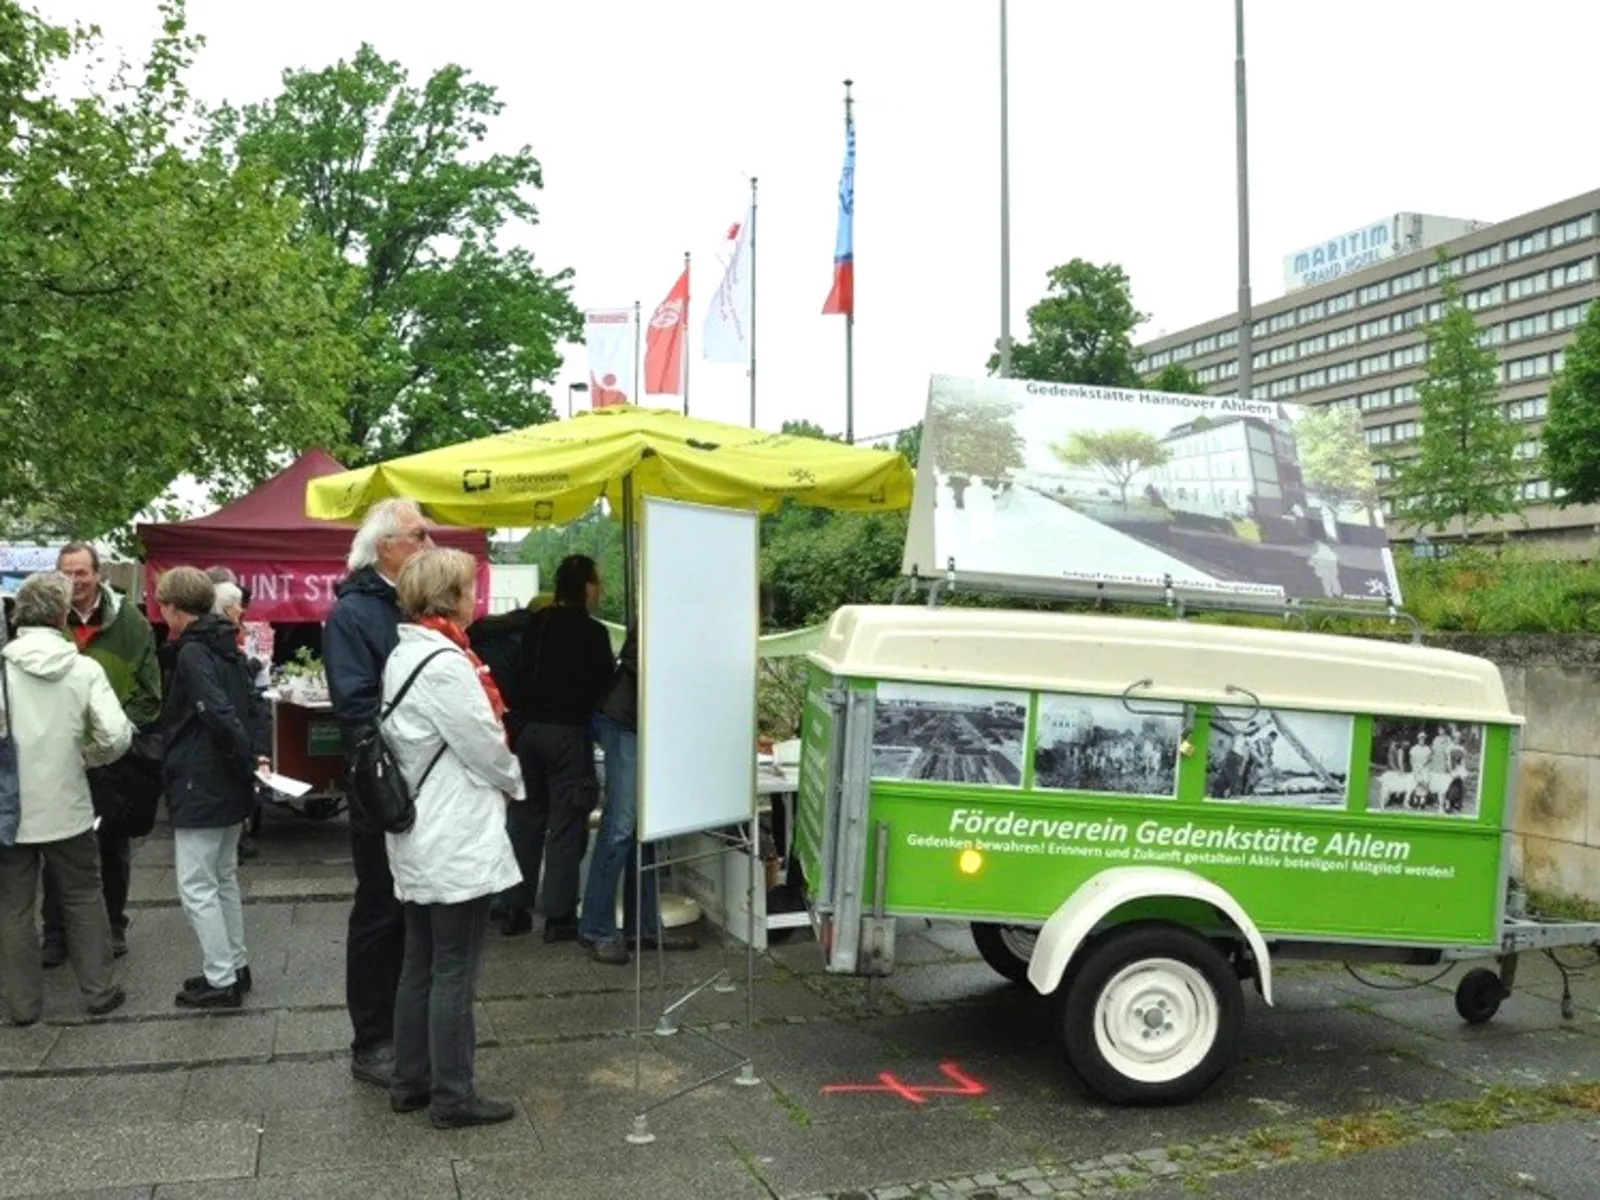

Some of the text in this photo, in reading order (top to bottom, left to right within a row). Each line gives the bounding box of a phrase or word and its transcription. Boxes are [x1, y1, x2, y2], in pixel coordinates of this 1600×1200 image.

[1293, 224, 1388, 275] MARITIM
[1025, 381, 1273, 415] Gedenkstätte Hannover Ahlem
[240, 573, 295, 601] UNT
[949, 808, 1412, 861] Förderverein Gedenkstätte Ahlem
[1047, 843, 1103, 858] Erinnern
[1105, 848, 1130, 859] und
[1132, 848, 1182, 862] Zukunft
[1183, 852, 1247, 865] gestalten!
[1248, 854, 1281, 867] Aktiv
[1351, 860, 1402, 876] Mitglied
